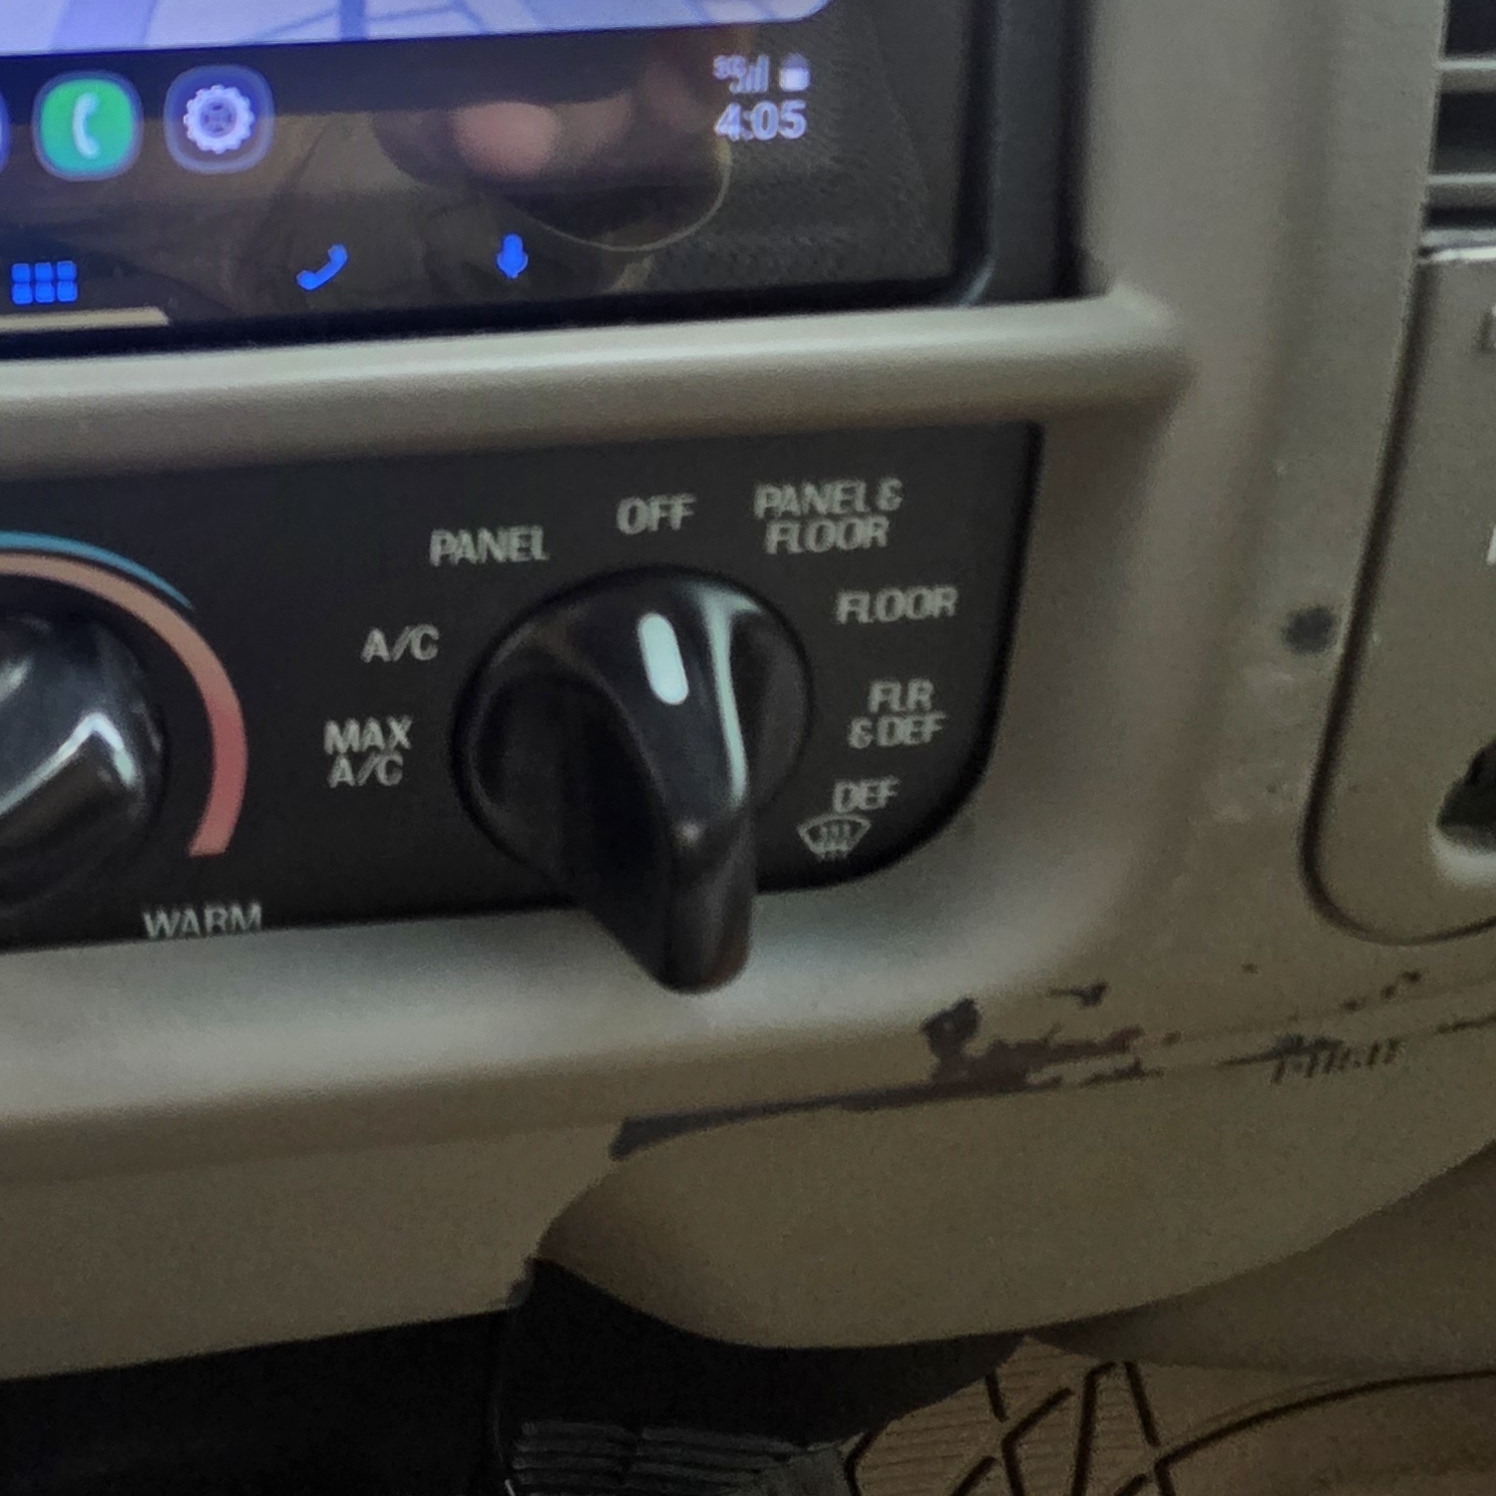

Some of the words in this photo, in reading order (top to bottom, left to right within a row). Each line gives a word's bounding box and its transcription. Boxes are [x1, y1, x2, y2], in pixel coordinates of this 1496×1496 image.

[714, 100, 807, 141] 4:05
[616, 493, 698, 536] OFF
[755, 478, 870, 520] PANEL
[428, 524, 550, 567] PANEL
[765, 514, 890, 554] FLOOR
[835, 585, 959, 625] FLOOR
[360, 623, 441, 664] A/C
[868, 678, 935, 713] FLR
[323, 715, 414, 755] MAX
[326, 752, 404, 789] A/C
[832, 775, 901, 814] DEF
[142, 903, 263, 939] WARM
